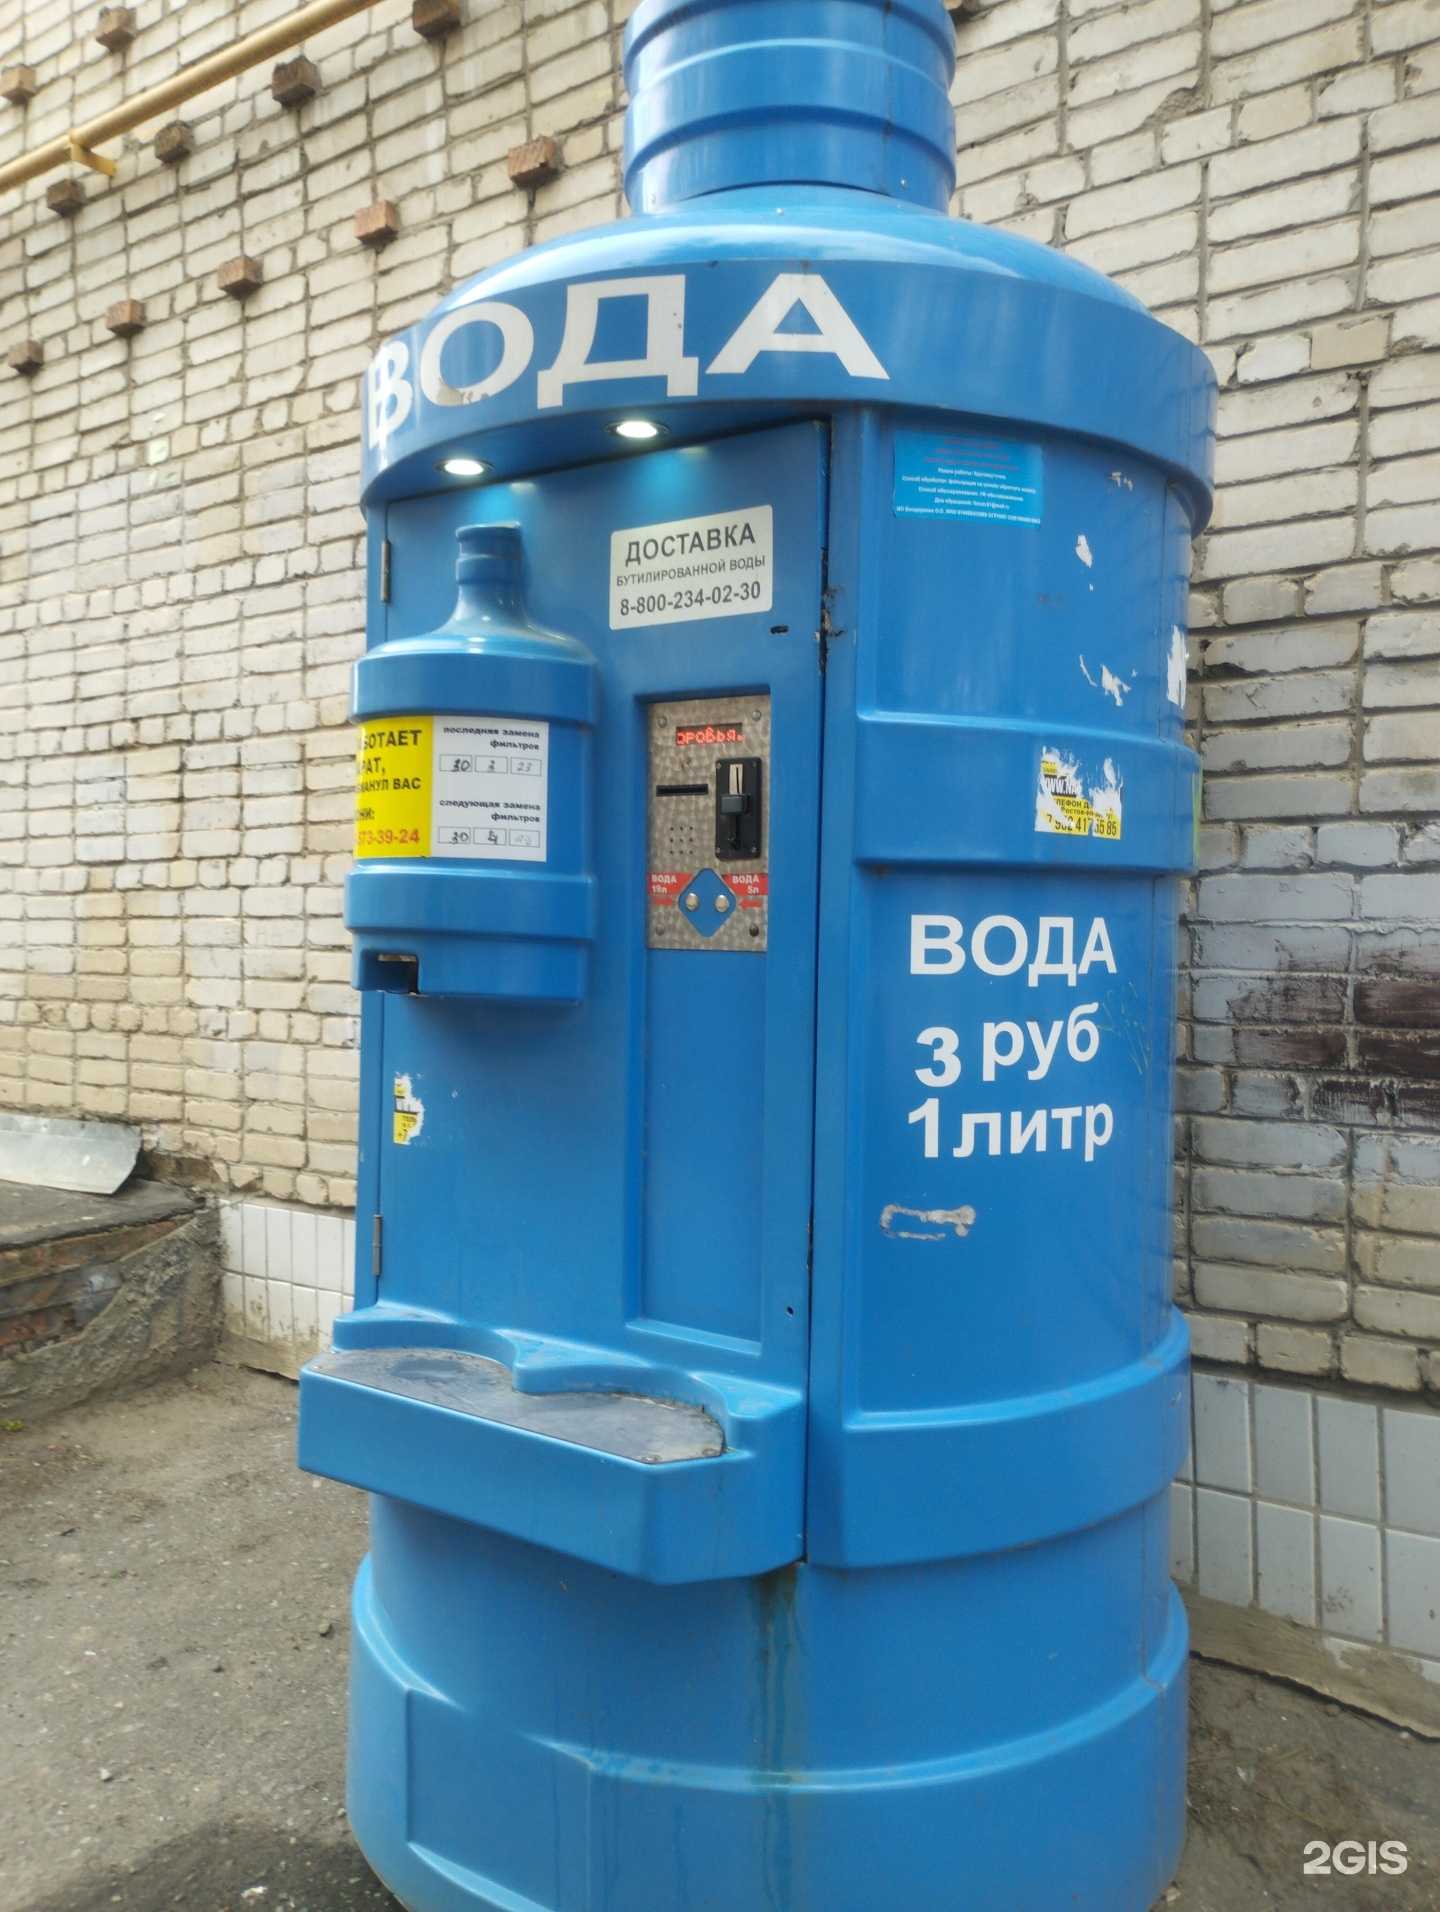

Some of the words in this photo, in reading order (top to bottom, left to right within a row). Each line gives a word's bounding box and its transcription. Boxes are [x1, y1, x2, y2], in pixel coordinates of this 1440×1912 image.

[368, 273, 891, 452] ВОДА
[625, 522, 756, 567] ДОСТАВКА
[616, 558, 726, 587] БУТИЛИРОВАННОЙ
[729, 555, 766, 571] ВОДЫ
[620, 580, 761, 616] 8-800-234-02-30
[443, 726, 499, 736] последняя
[502, 729, 540, 738] замена
[490, 739, 540, 751] фильтров
[393, 777, 421, 790] ВАС
[439, 800, 500, 809] следующая
[503, 802, 541, 811] замена
[491, 812, 540, 823] фильтров
[651, 874, 678, 884] ВОДА
[732, 874, 760, 884] ВОДА
[910, 914, 1118, 987] ВОДА
[914, 1026, 962, 1088] 3
[982, 1002, 1099, 1082] руб
